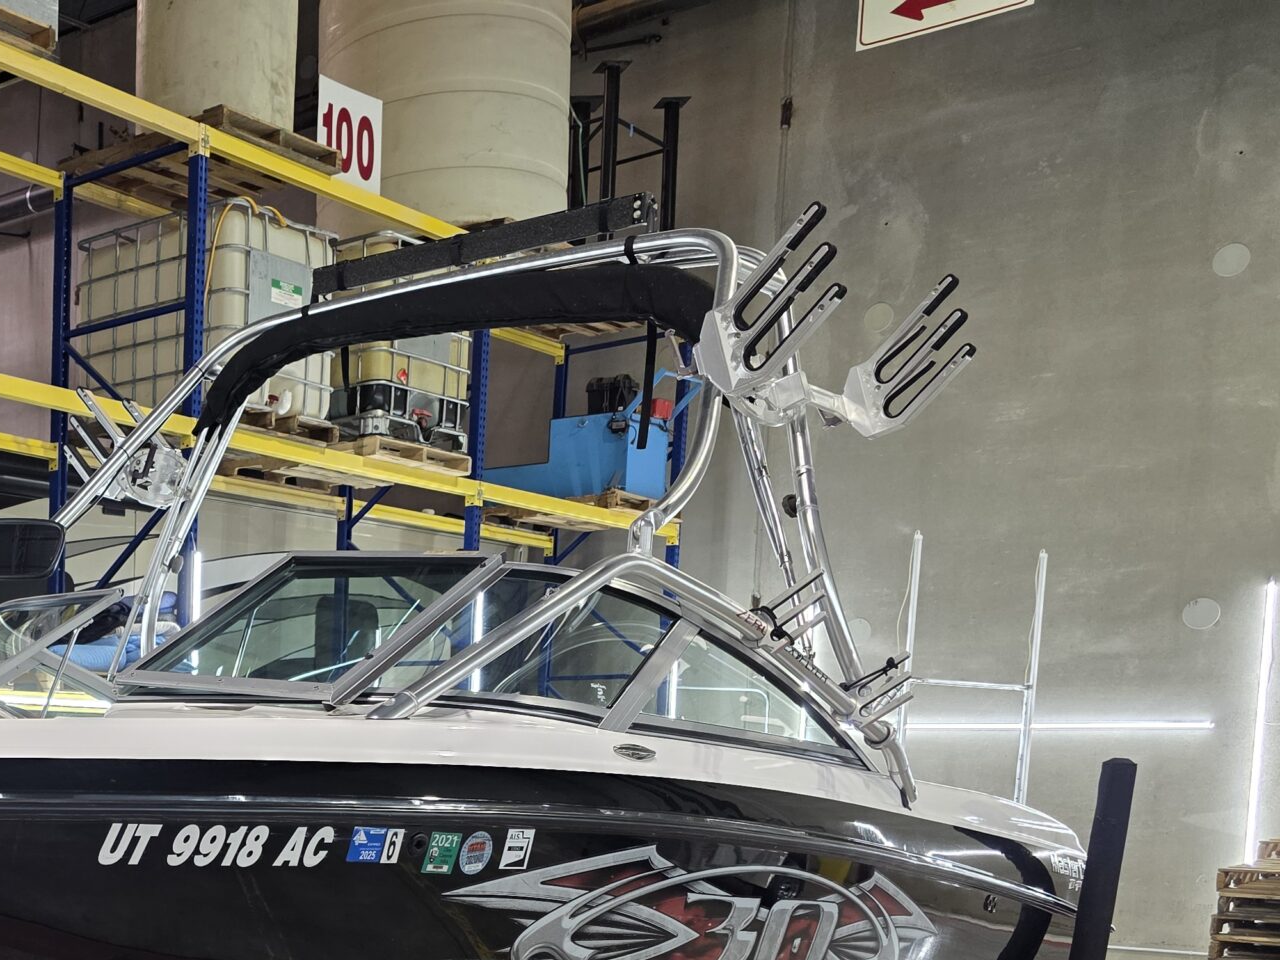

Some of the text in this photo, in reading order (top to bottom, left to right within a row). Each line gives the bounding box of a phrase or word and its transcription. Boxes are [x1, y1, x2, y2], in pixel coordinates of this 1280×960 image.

[322, 102, 375, 182] 100
[98, 823, 335, 868] UT 9918 AC
[358, 850, 377, 860] 2025
[386, 831, 399, 861] 6
